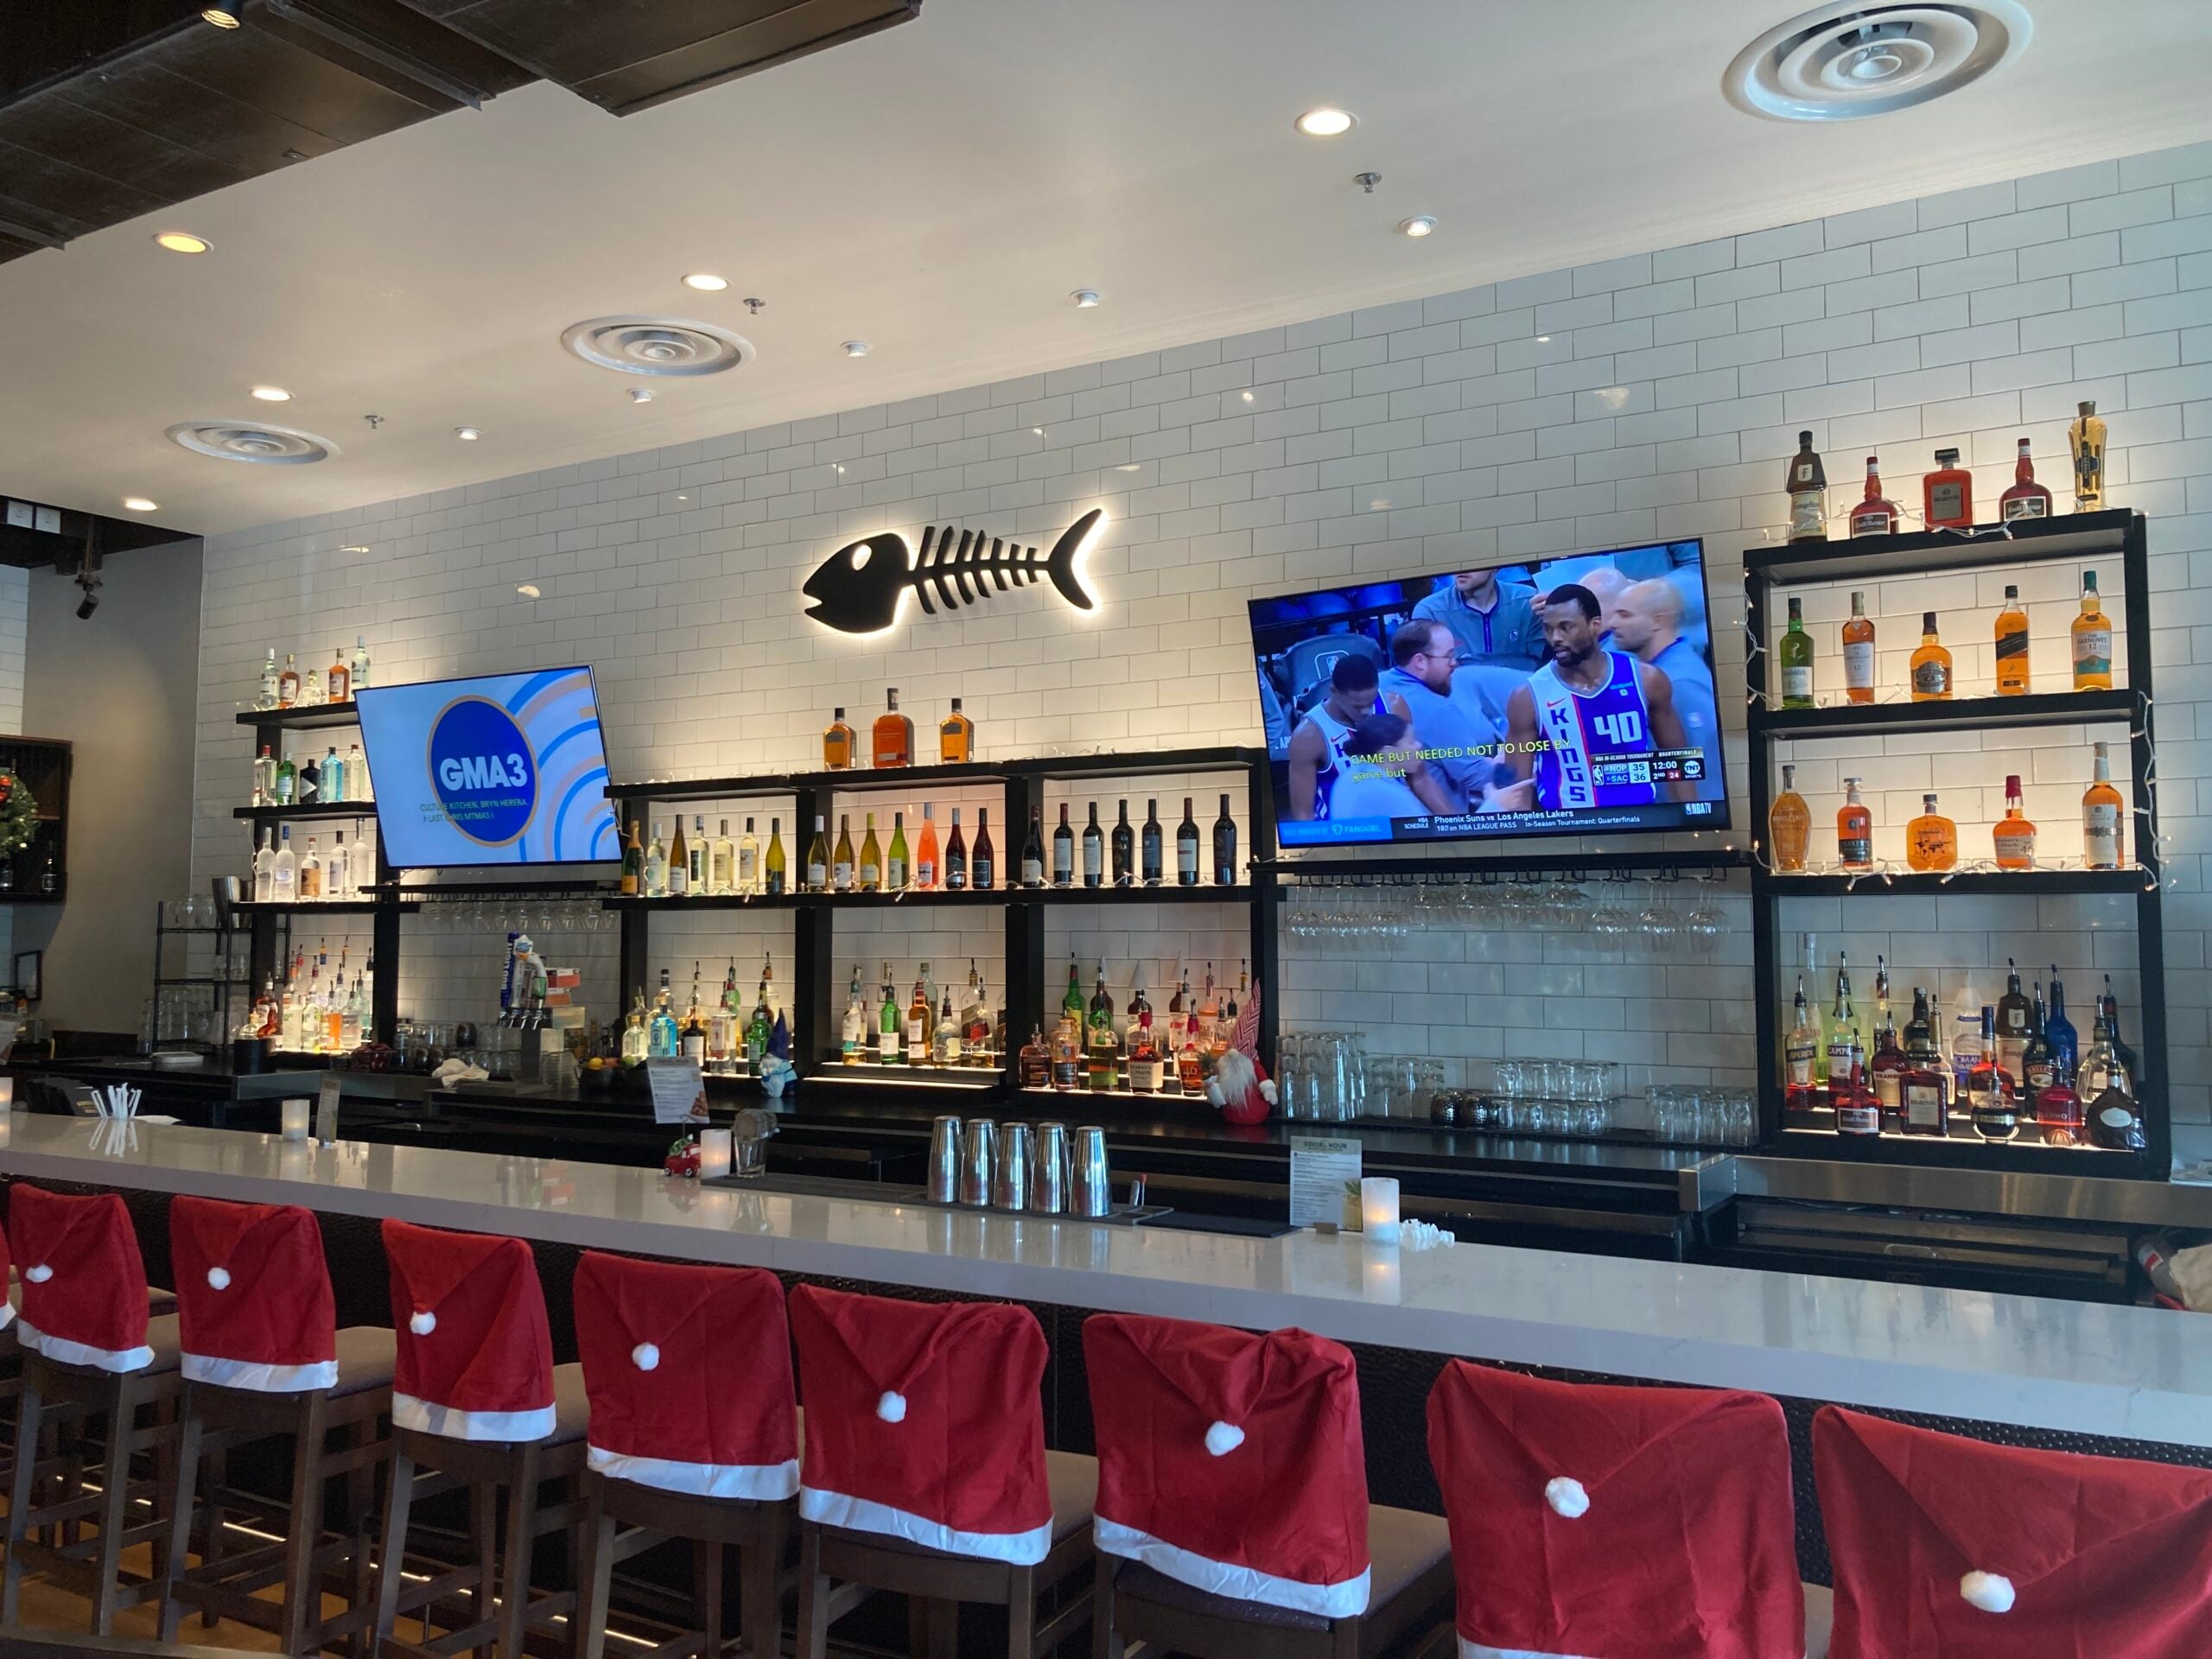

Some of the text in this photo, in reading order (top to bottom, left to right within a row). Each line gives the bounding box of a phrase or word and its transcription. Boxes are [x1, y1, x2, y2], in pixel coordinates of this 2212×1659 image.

[1593, 710, 1642, 745] 40
[1350, 739, 1571, 766] GAME BUT NEEDED NOT TO LOSE BY
[1549, 708, 1586, 802] KINGS
[1610, 764, 1627, 772] NOP
[1632, 763, 1645, 772] 35
[1652, 760, 1677, 770] 12:00
[439, 753, 528, 791] GMA3
[1385, 767, 1407, 779] but
[1669, 771, 1679, 779] 24
[1633, 773, 1646, 782] 36
[1513, 811, 1545, 821] Angeles
[1546, 810, 1574, 818] Lakers
[1598, 816, 1641, 824] Quarterfinals
[1827, 1046, 1853, 1055] CAMPA
[1183, 1066, 1198, 1079] 46
